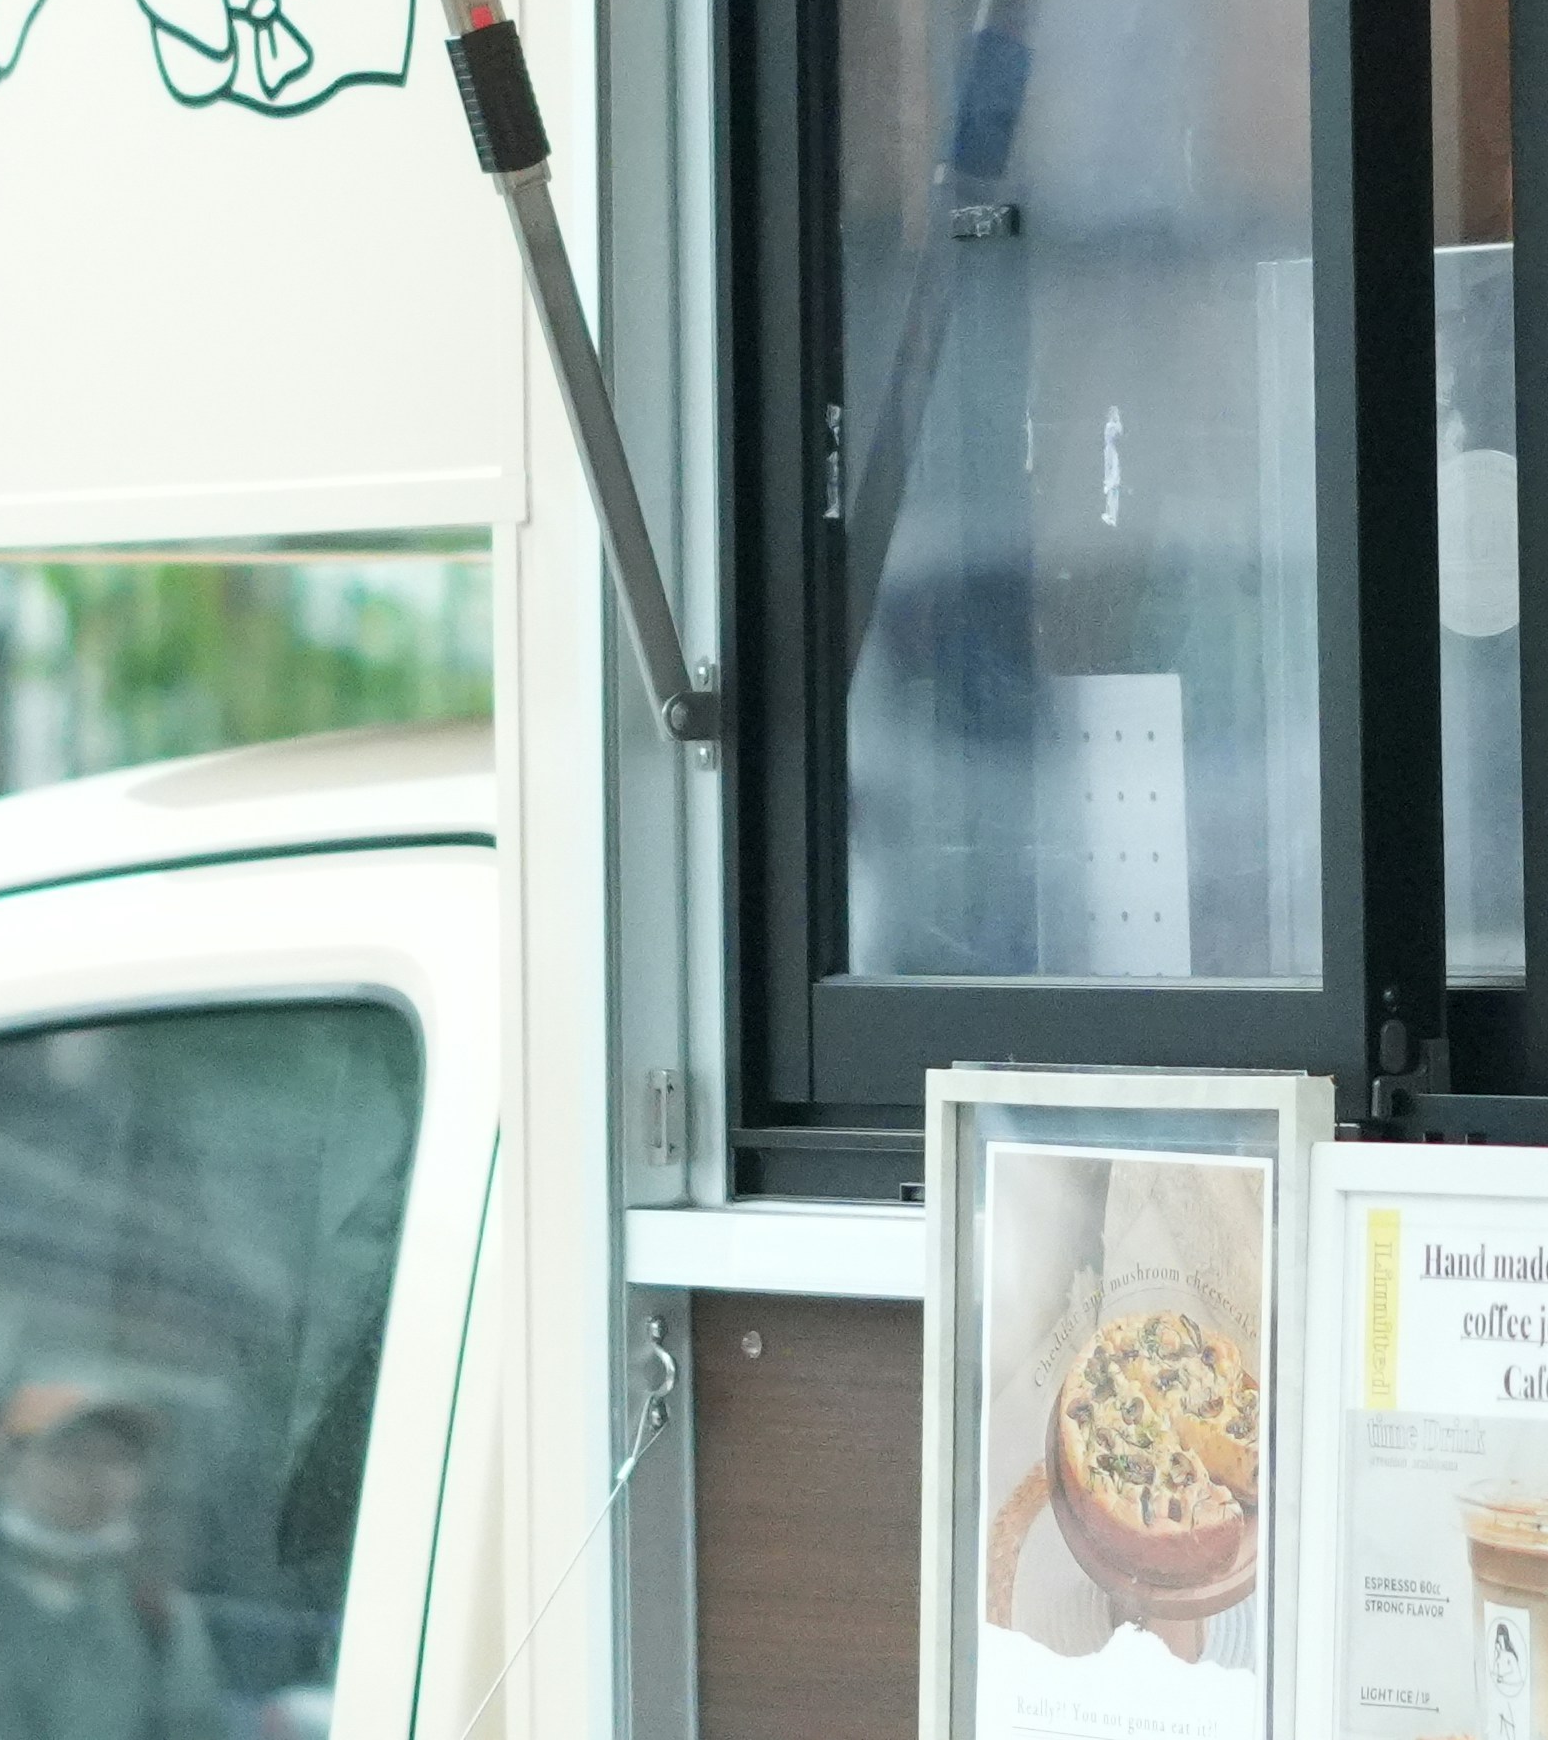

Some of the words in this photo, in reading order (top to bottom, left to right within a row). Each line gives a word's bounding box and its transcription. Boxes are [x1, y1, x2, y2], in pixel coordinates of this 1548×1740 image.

[1423, 1243, 1486, 1279] Hand
[1034, 1311, 1080, 1388] Cheddar
[1083, 1281, 1107, 1315] and
[1110, 1263, 1181, 1292] mushroom
[1185, 1269, 1258, 1339] cheesecake
[1462, 1302, 1533, 1341] coffee
[1364, 1576, 1417, 1594] ESPRESSO
[1406, 1602, 1444, 1618] FLAVOR
[1360, 1686, 1393, 1702] LIGHT
[1396, 1689, 1414, 1705] ICE
[1072, 1702, 1098, 1723] You
[1103, 1712, 1123, 1727] not
[1127, 1715, 1166, 1735] gonna
[1171, 1720, 1191, 1736] eat
